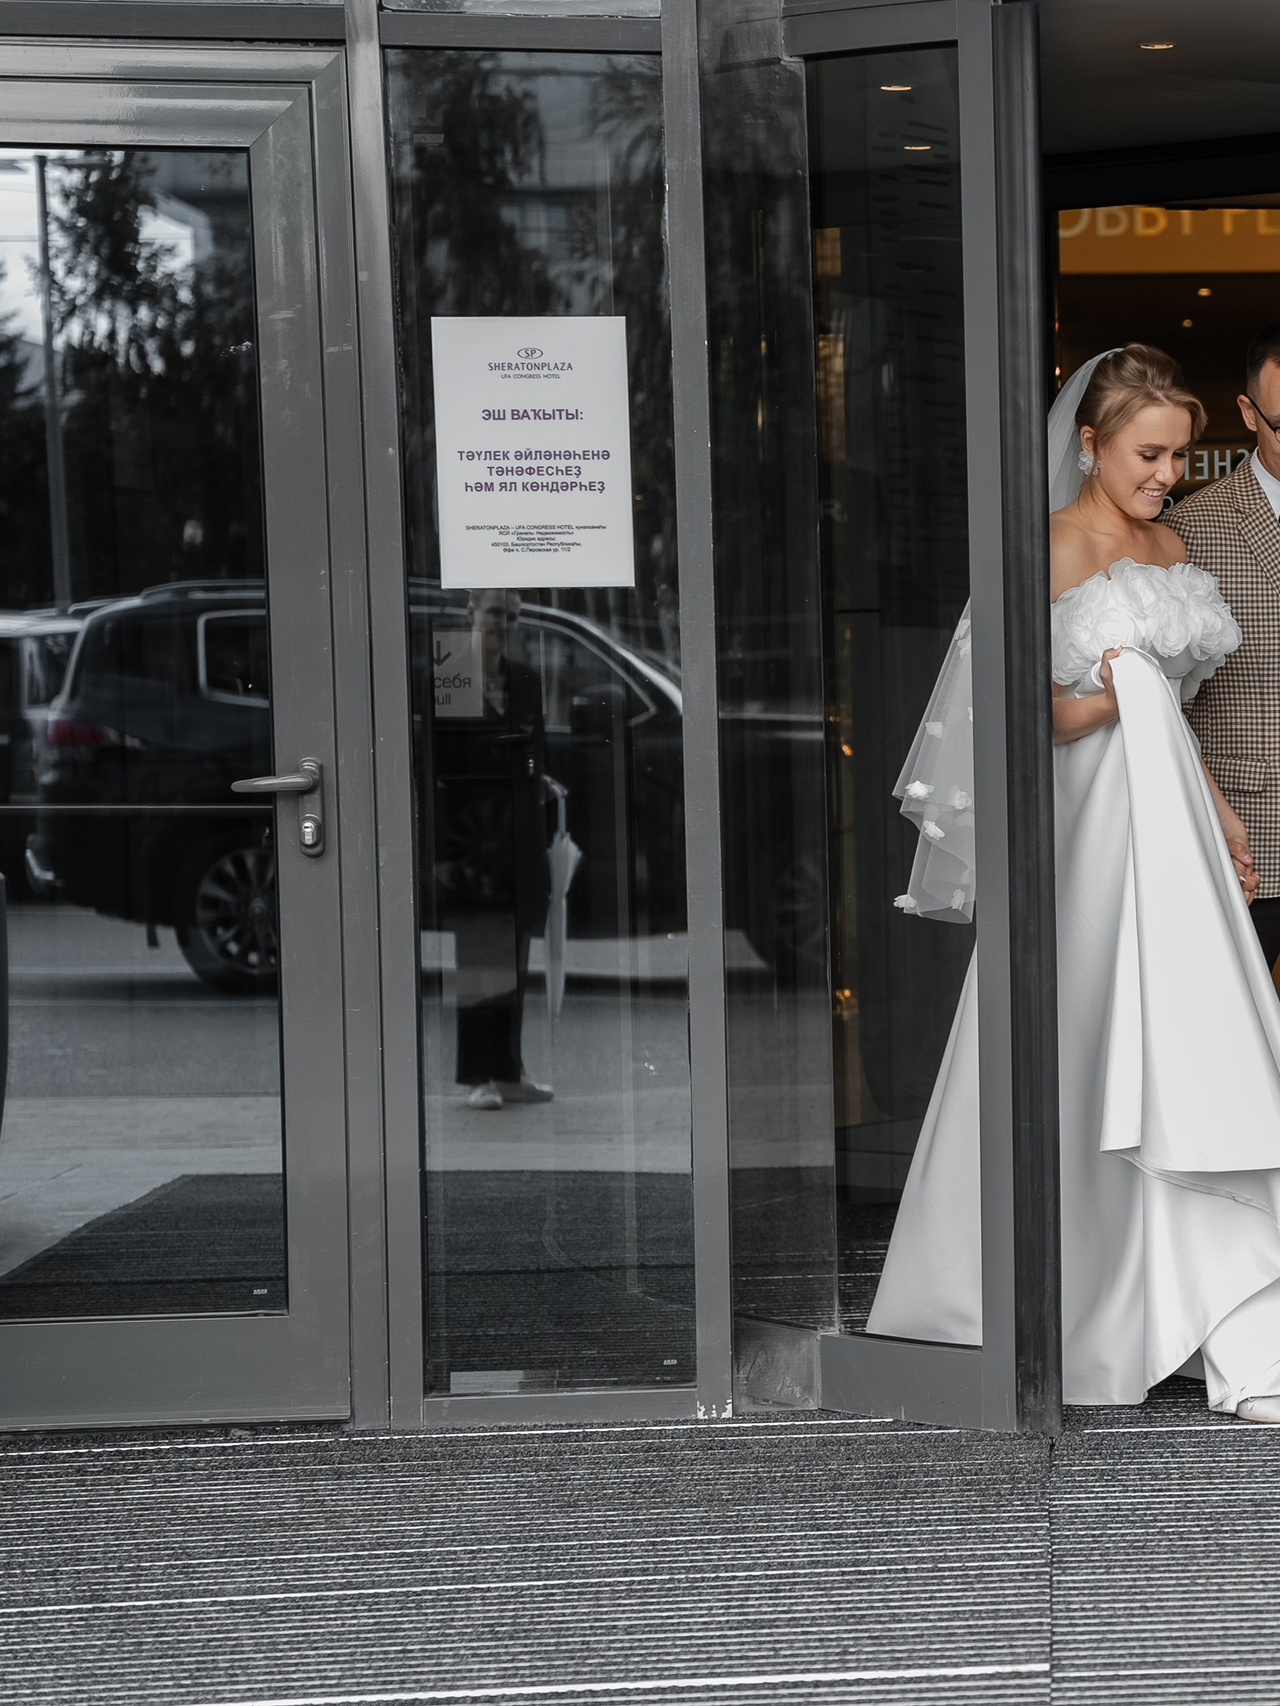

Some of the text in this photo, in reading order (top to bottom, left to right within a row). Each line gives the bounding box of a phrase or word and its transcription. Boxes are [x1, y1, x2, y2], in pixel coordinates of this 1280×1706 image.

[488, 362, 573, 371] SHERATONPLAZA
[481, 409, 506, 421] ЭШ
[498, 481, 518, 492] ЯЛ
[435, 692, 451, 706] ull
